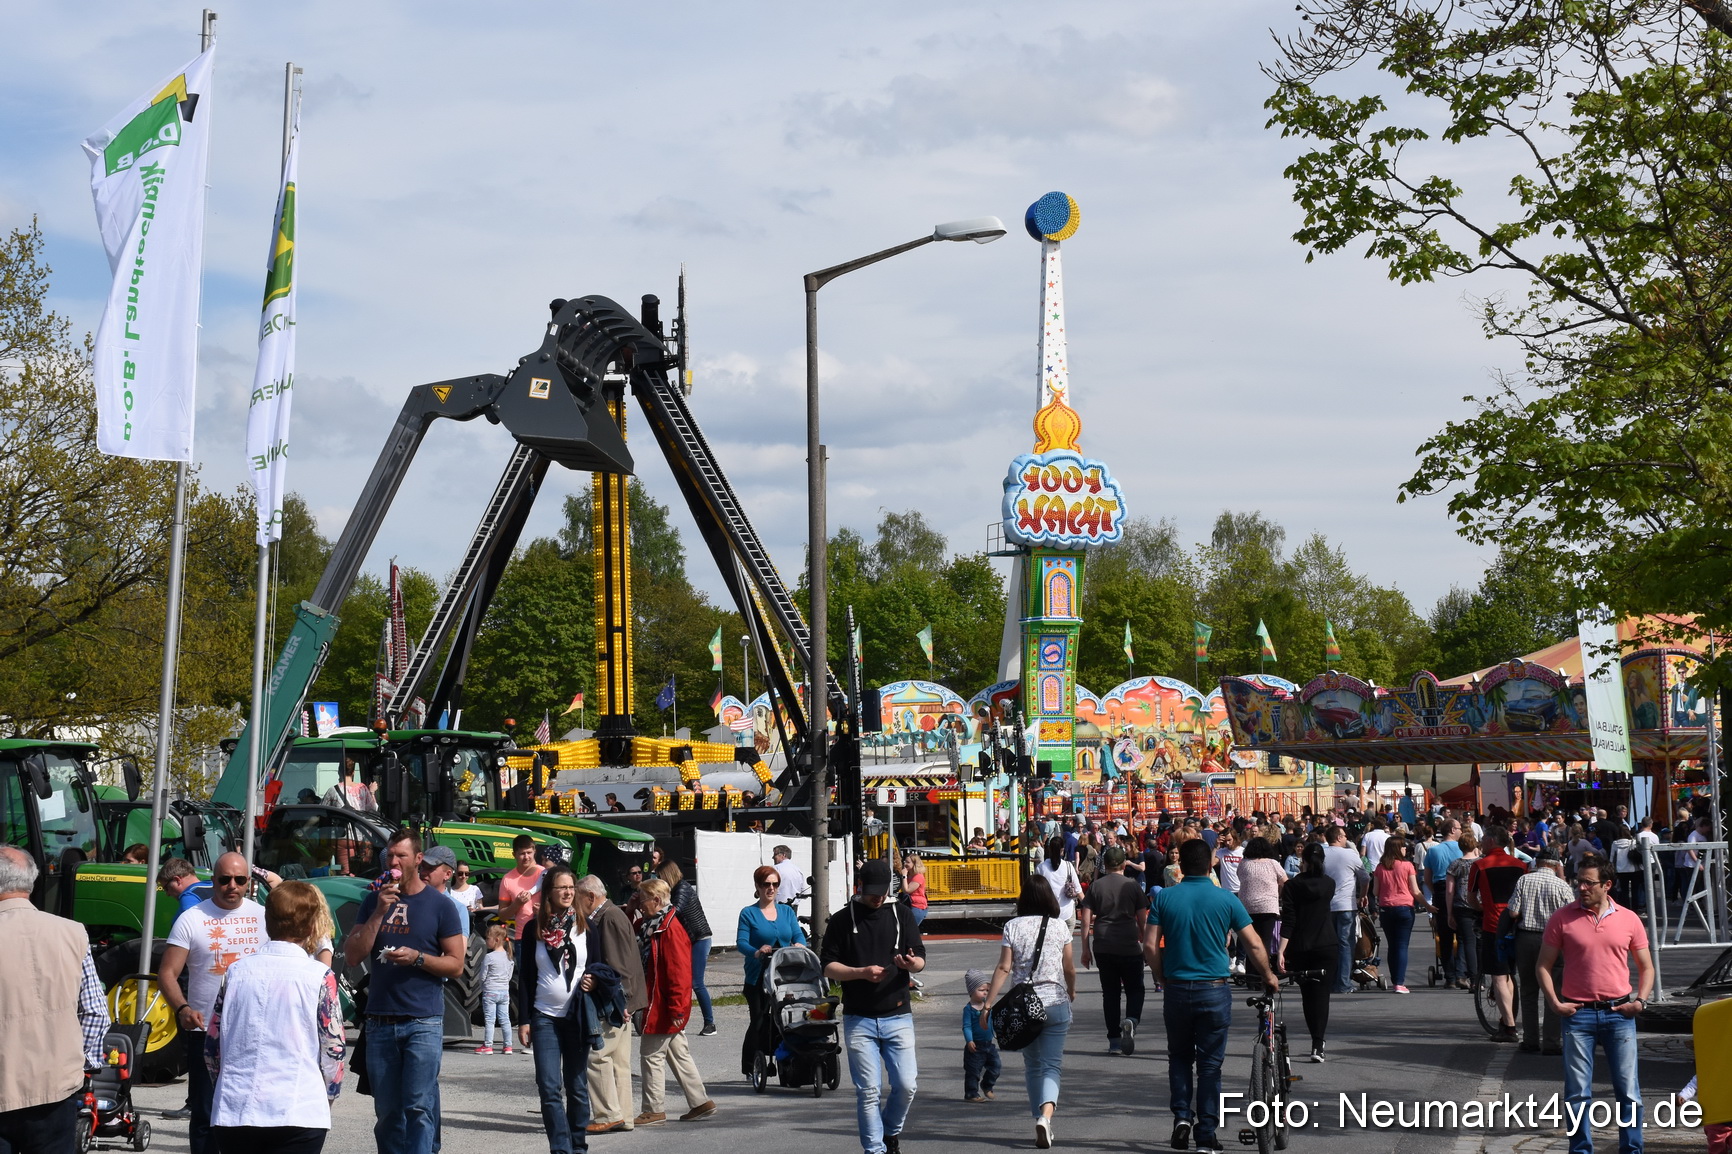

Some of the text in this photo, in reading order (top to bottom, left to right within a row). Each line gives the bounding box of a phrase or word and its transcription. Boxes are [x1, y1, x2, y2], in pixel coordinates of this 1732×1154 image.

[1024, 465, 1101, 494] 1001
[1018, 494, 1118, 537] NACHT
[267, 635, 302, 696] KRAMER
[203, 916, 258, 926] HOLLISTER
[387, 903, 409, 925] A
[227, 937, 259, 945] SERIES
